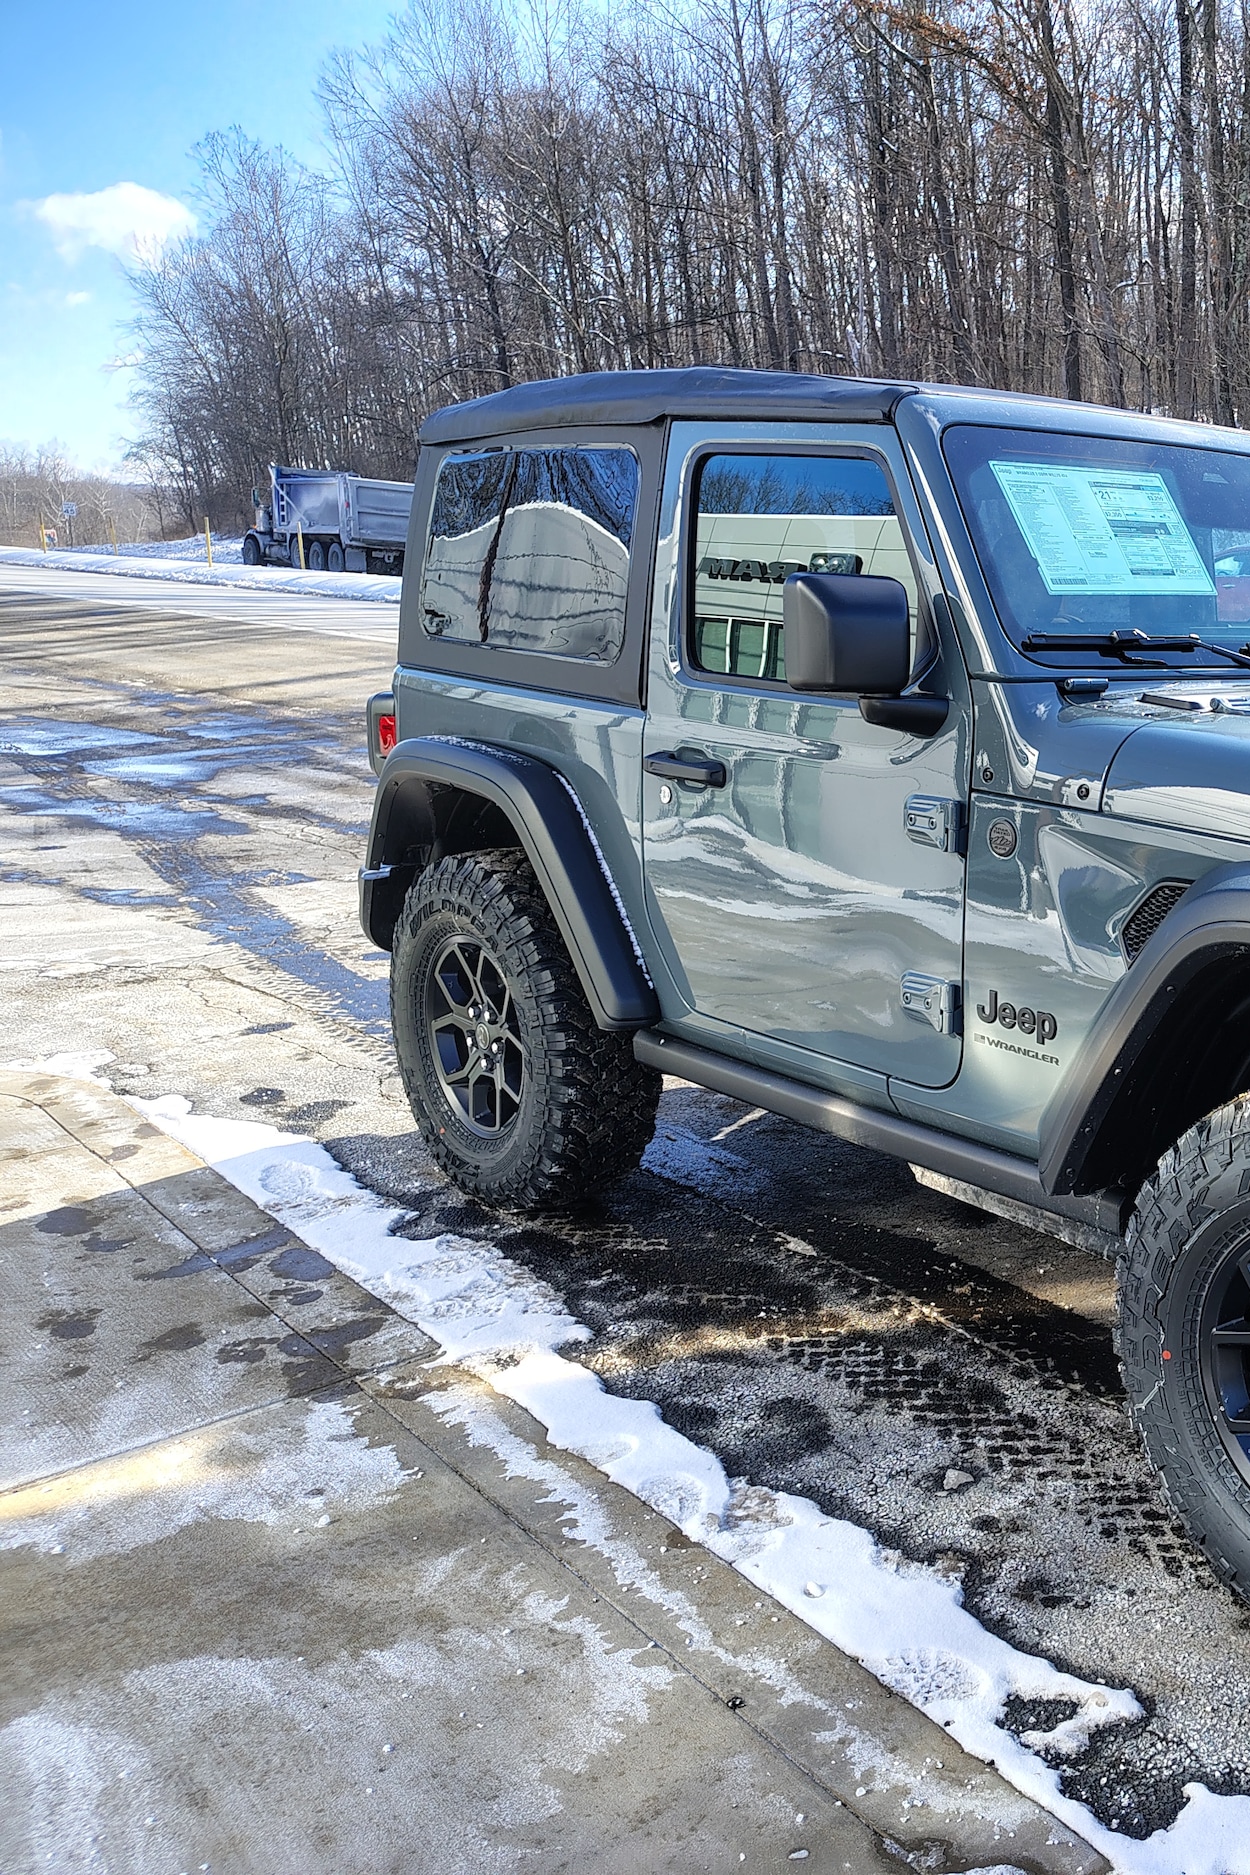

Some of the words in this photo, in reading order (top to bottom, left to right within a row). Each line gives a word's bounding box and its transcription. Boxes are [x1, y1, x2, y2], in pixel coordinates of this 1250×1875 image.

[1098, 490, 1112, 500] 21
[976, 989, 1058, 1046] Jeep
[985, 1035, 1061, 1067] WRANGLER
